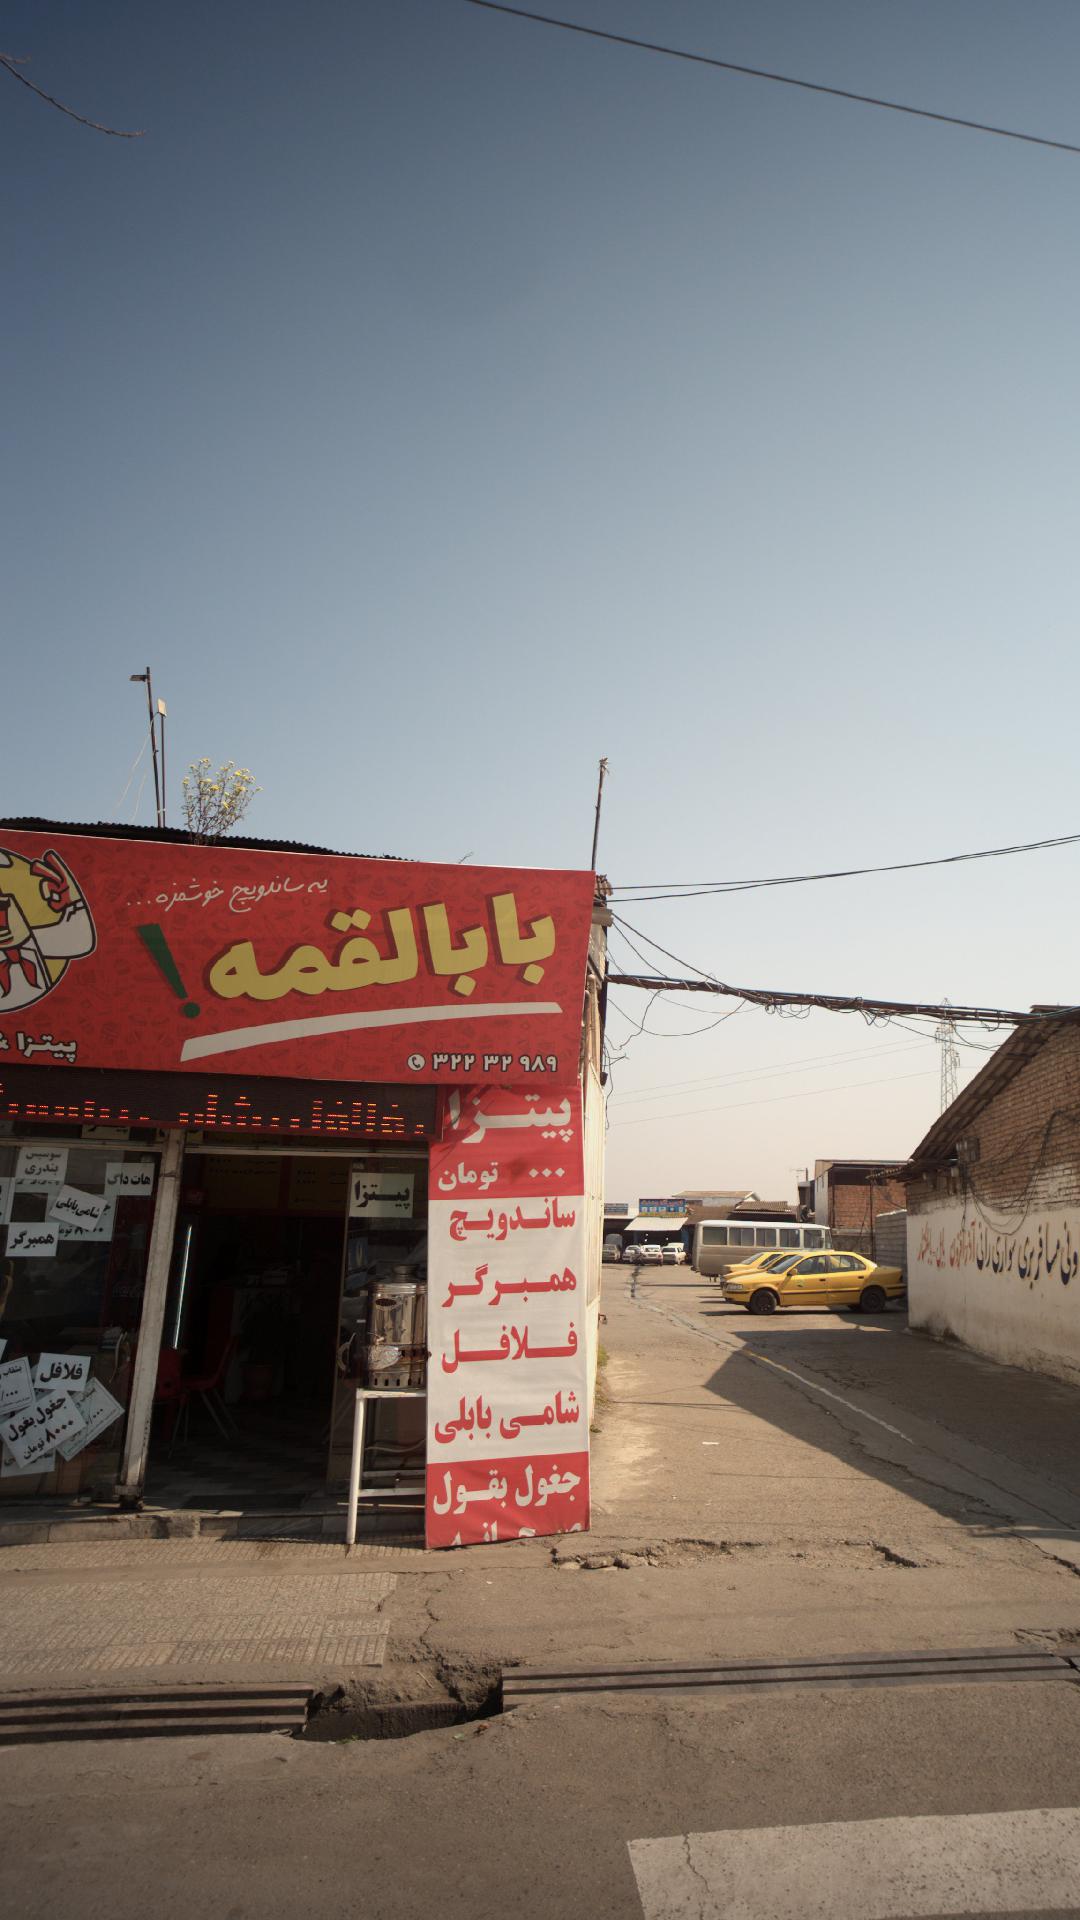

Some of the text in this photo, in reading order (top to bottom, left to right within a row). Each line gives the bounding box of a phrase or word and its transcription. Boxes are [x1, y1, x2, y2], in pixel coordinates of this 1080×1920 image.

[16, 1031, 77, 1063] پیتزا
[519, 1055, 558, 1072] ۹۸۹
[449, 1090, 574, 1144] پیتزا
[24, 1163, 59, 1176] بندری
[131, 1172, 151, 1185] هات
[438, 1161, 499, 1191] تومان
[354, 1179, 411, 1210] پیتزا
[449, 1196, 576, 1241] ساندویچ
[9, 1230, 54, 1249] همبرگر
[441, 1262, 577, 1308] همبرگر
[442, 1322, 578, 1374] فلافل
[39, 1361, 83, 1382] فلافل
[36, 1397, 67, 1425] جغول
[434, 1390, 581, 1445] شامی بابلی
[45, 1420, 74, 1443] ۸۰۰۰
[23, 1438, 46, 1460] تومان
[433, 1463, 582, 1516] جغول بقول
